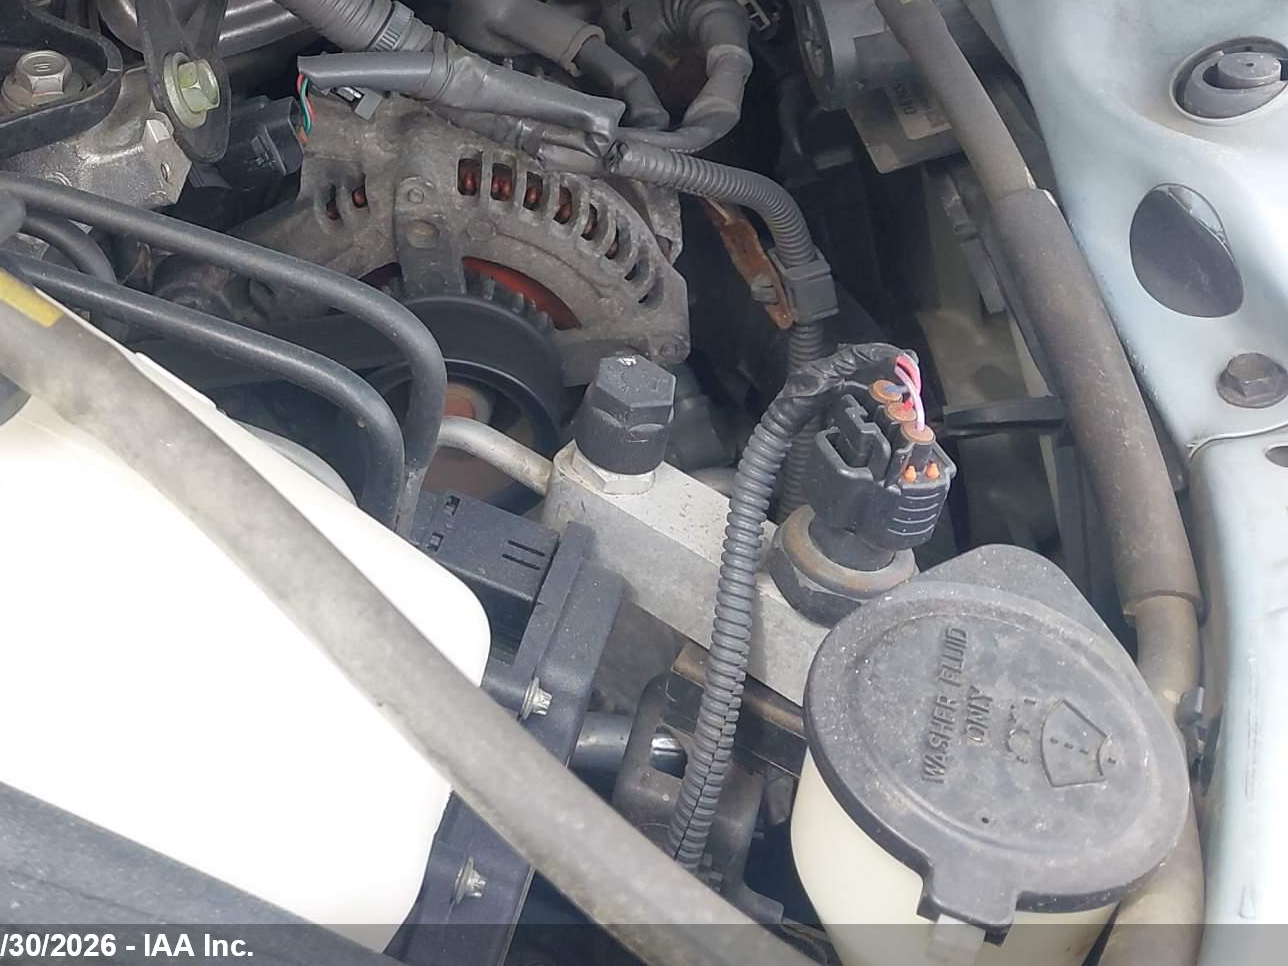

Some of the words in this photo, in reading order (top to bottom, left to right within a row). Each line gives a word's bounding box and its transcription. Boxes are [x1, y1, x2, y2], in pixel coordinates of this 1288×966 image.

[937, 628, 968, 687] FLUID
[922, 695, 958, 784] WASHER
[966, 685, 994, 743] ONLY
